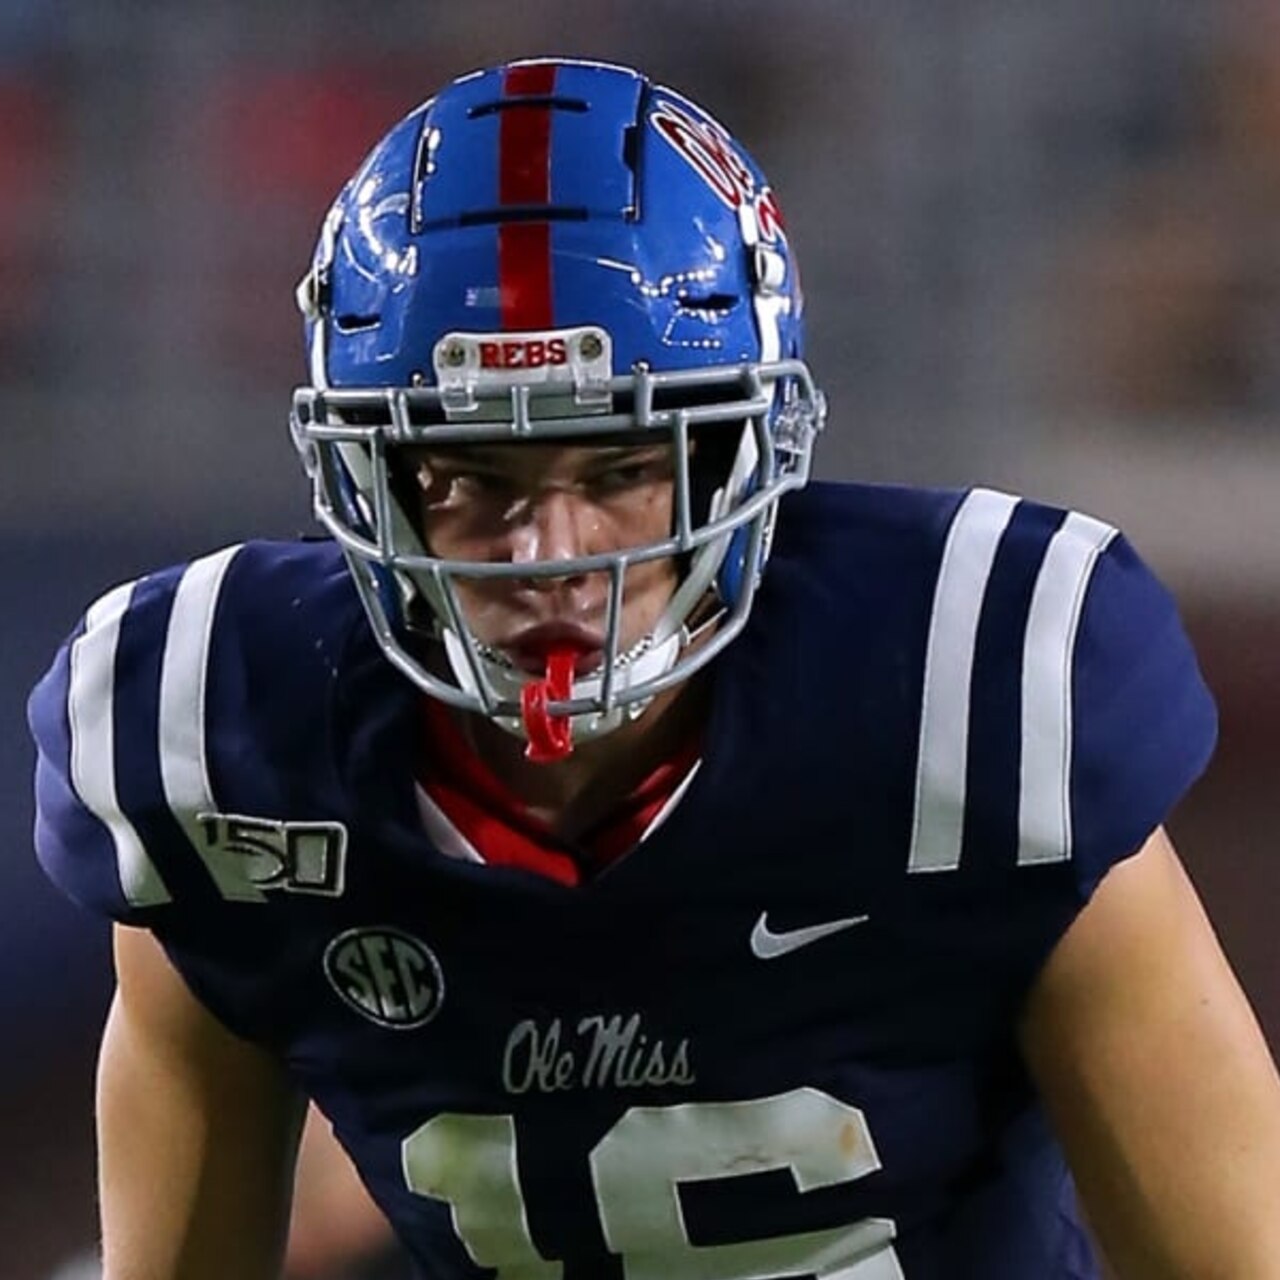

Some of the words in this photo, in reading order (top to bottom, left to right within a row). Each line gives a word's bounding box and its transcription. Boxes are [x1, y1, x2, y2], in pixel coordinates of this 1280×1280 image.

[478, 339, 567, 369] REBS
[335, 934, 432, 1019] SEC
[502, 1018, 574, 1094] Ole
[576, 1012, 696, 1089] Miss
